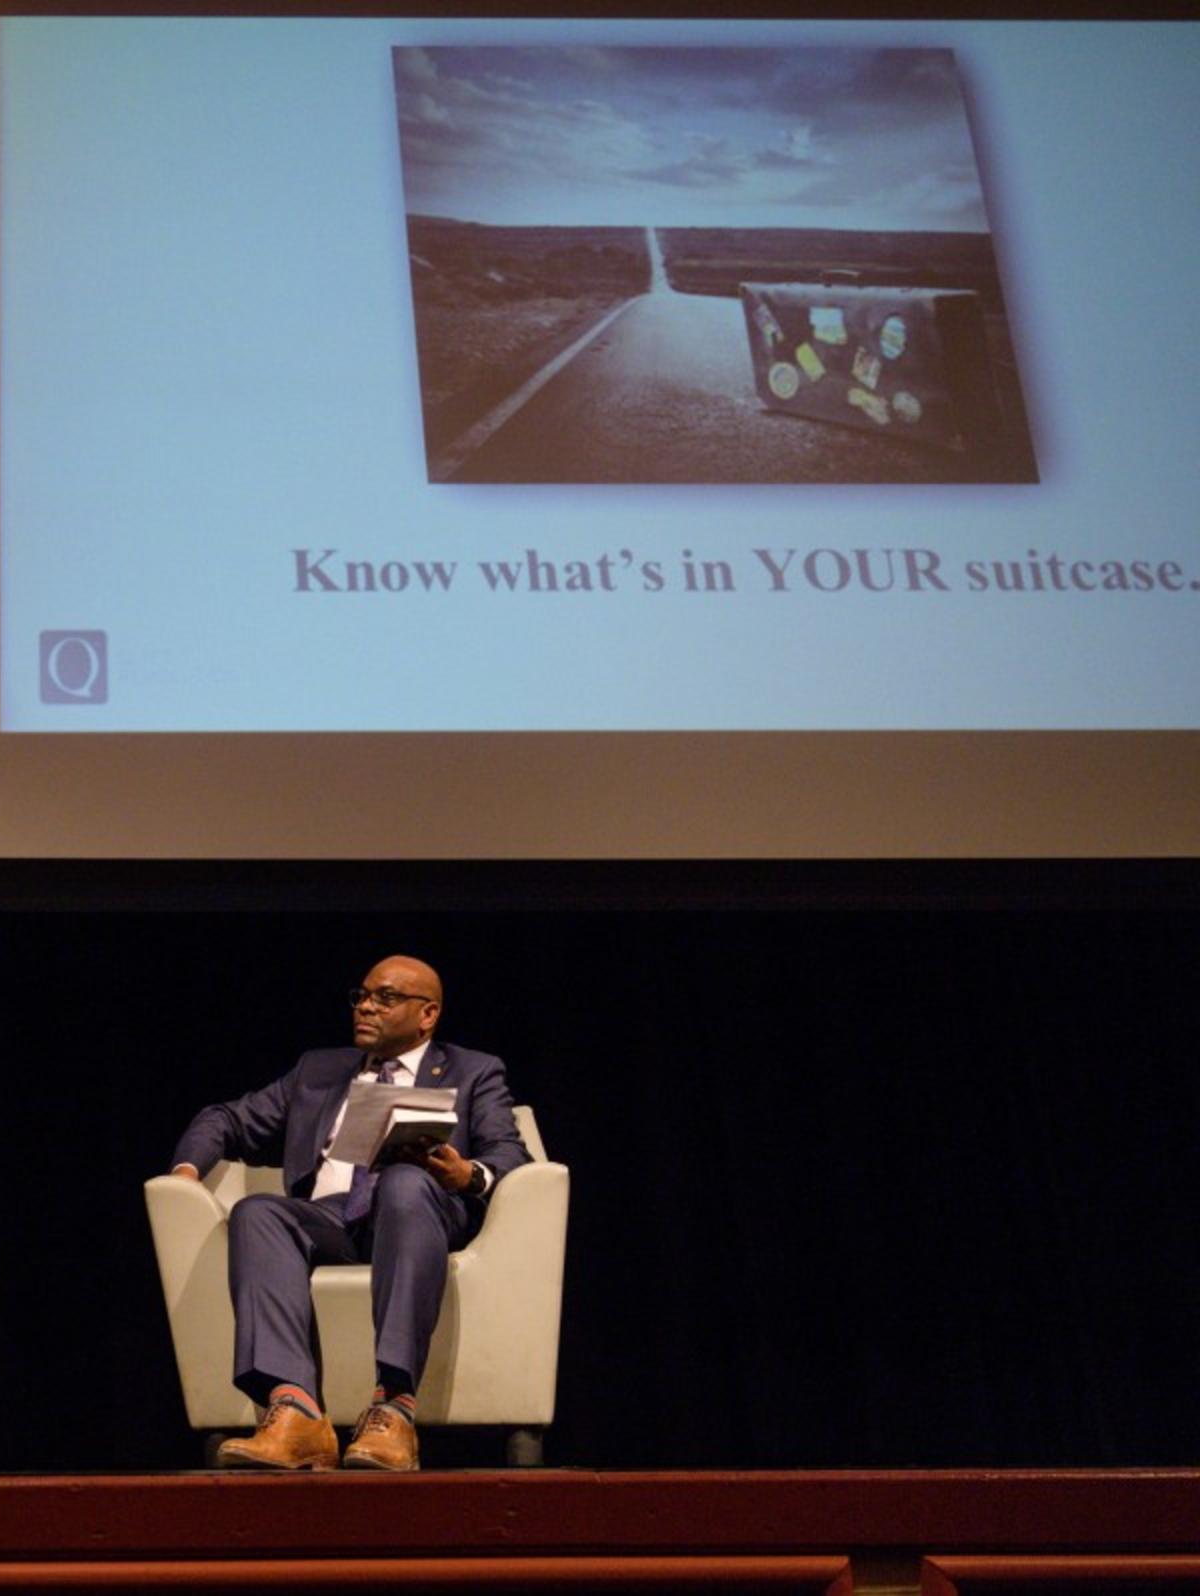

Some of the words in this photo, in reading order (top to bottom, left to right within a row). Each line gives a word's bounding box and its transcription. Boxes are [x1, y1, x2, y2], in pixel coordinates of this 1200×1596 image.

[291, 548, 458, 592] Know
[477, 549, 666, 592] what’s
[682, 549, 737, 592] in
[752, 548, 950, 593] YOUR
[965, 549, 1200, 592] suitcase.
[47, 637, 99, 697] Q
